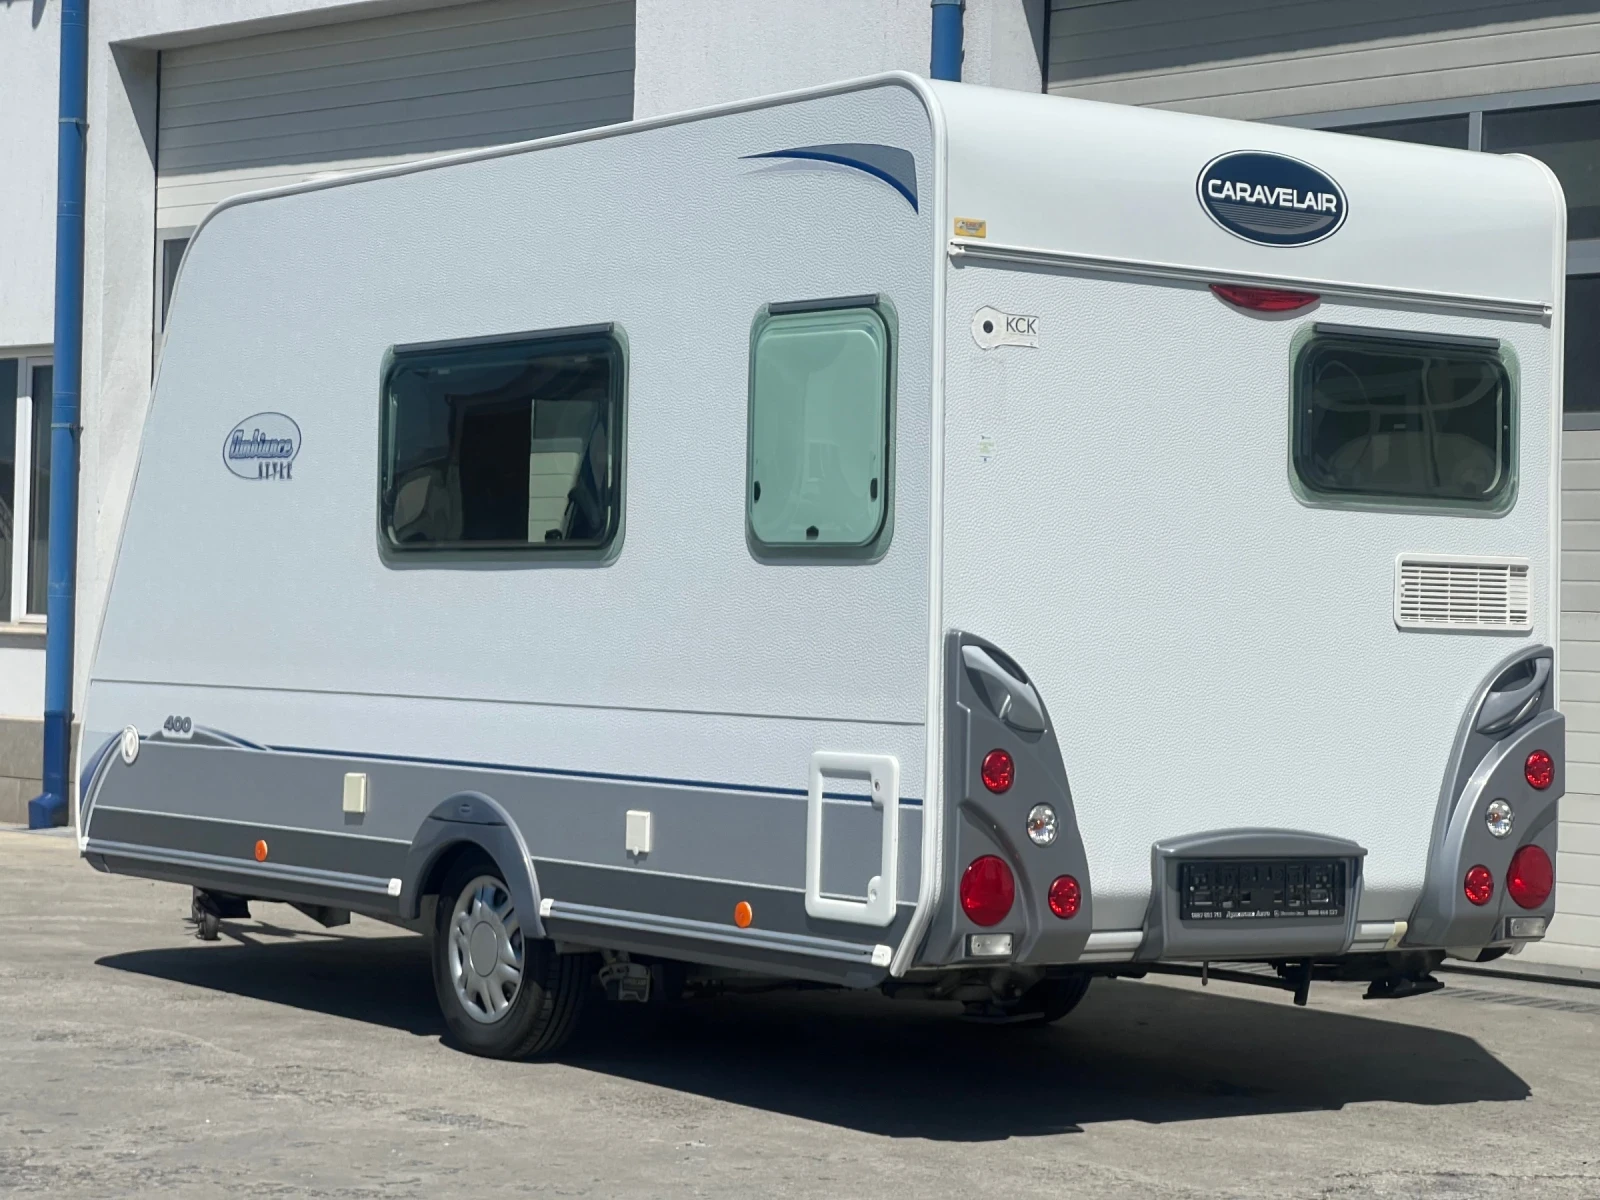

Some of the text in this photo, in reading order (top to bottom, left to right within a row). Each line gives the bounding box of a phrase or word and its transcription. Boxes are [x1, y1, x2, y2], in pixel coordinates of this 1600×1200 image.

[1208, 179, 1337, 212] CARAVELAIR
[1006, 316, 1037, 334] KCK
[163, 714, 192, 733] 400
